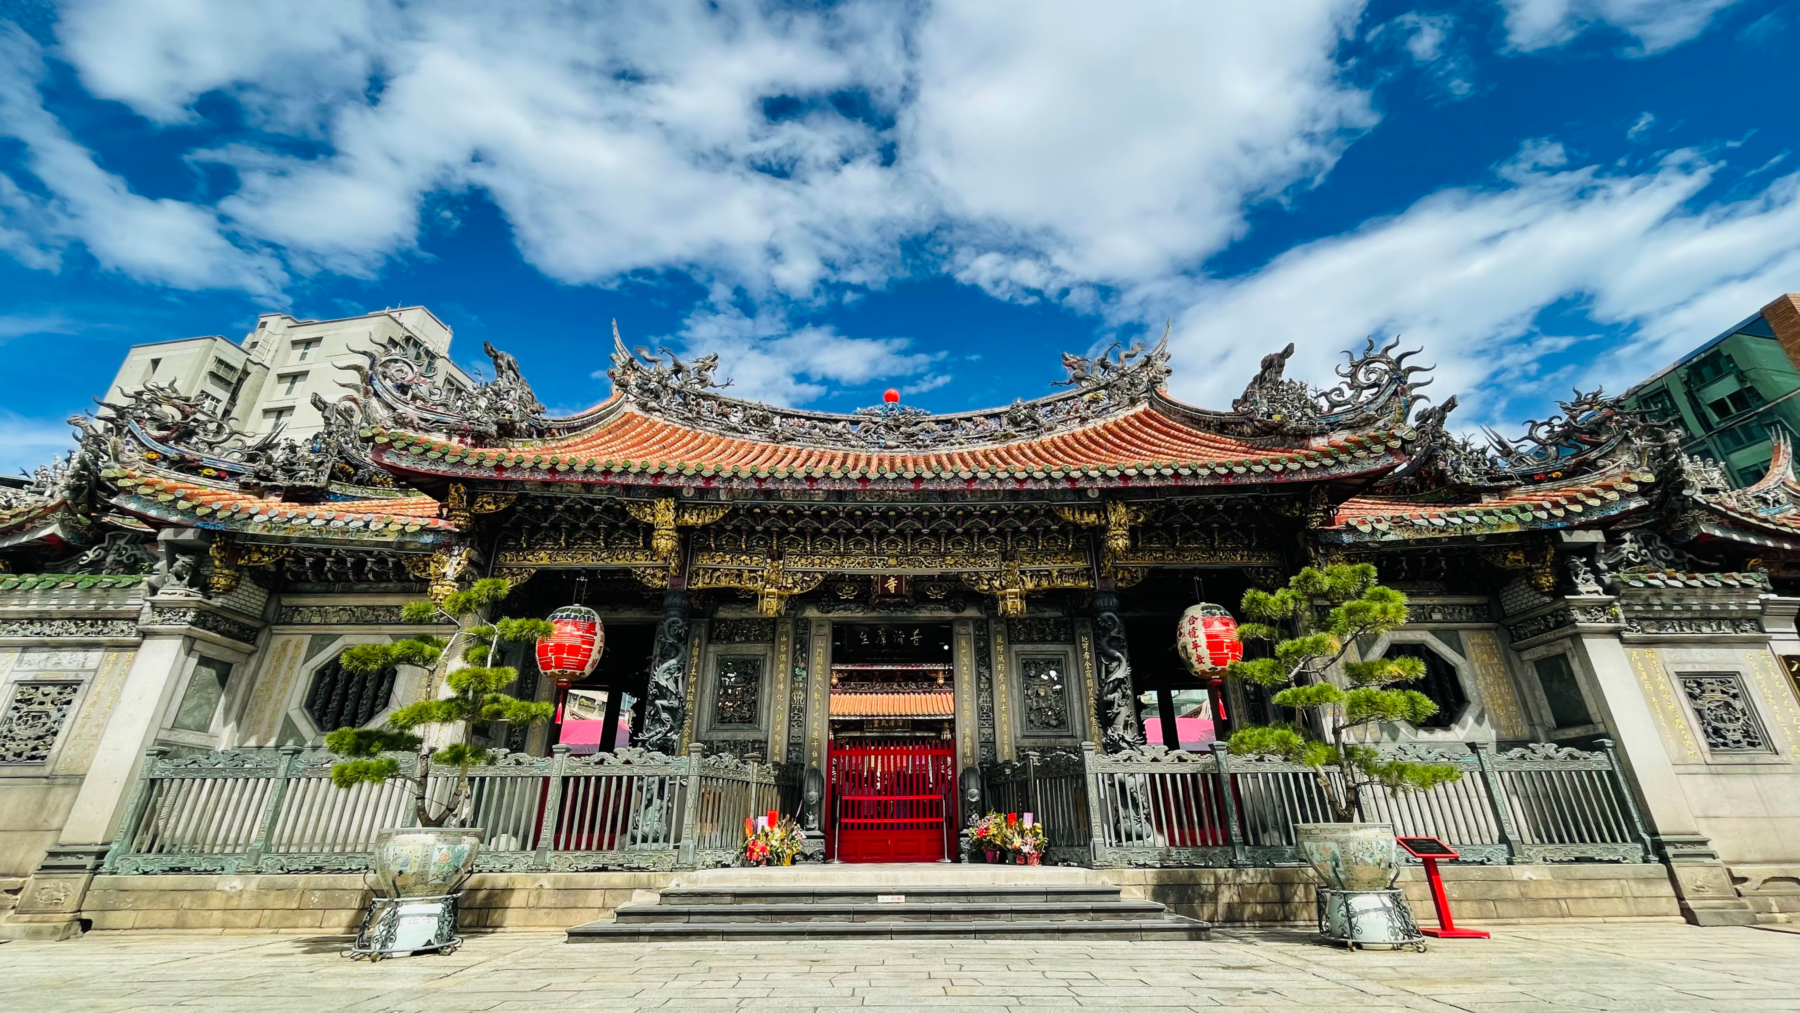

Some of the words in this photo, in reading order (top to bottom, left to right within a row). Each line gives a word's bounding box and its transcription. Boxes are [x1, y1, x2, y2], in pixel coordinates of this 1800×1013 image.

[884, 577, 898, 594] 寺
[1188, 615, 1206, 665] 合境平安
